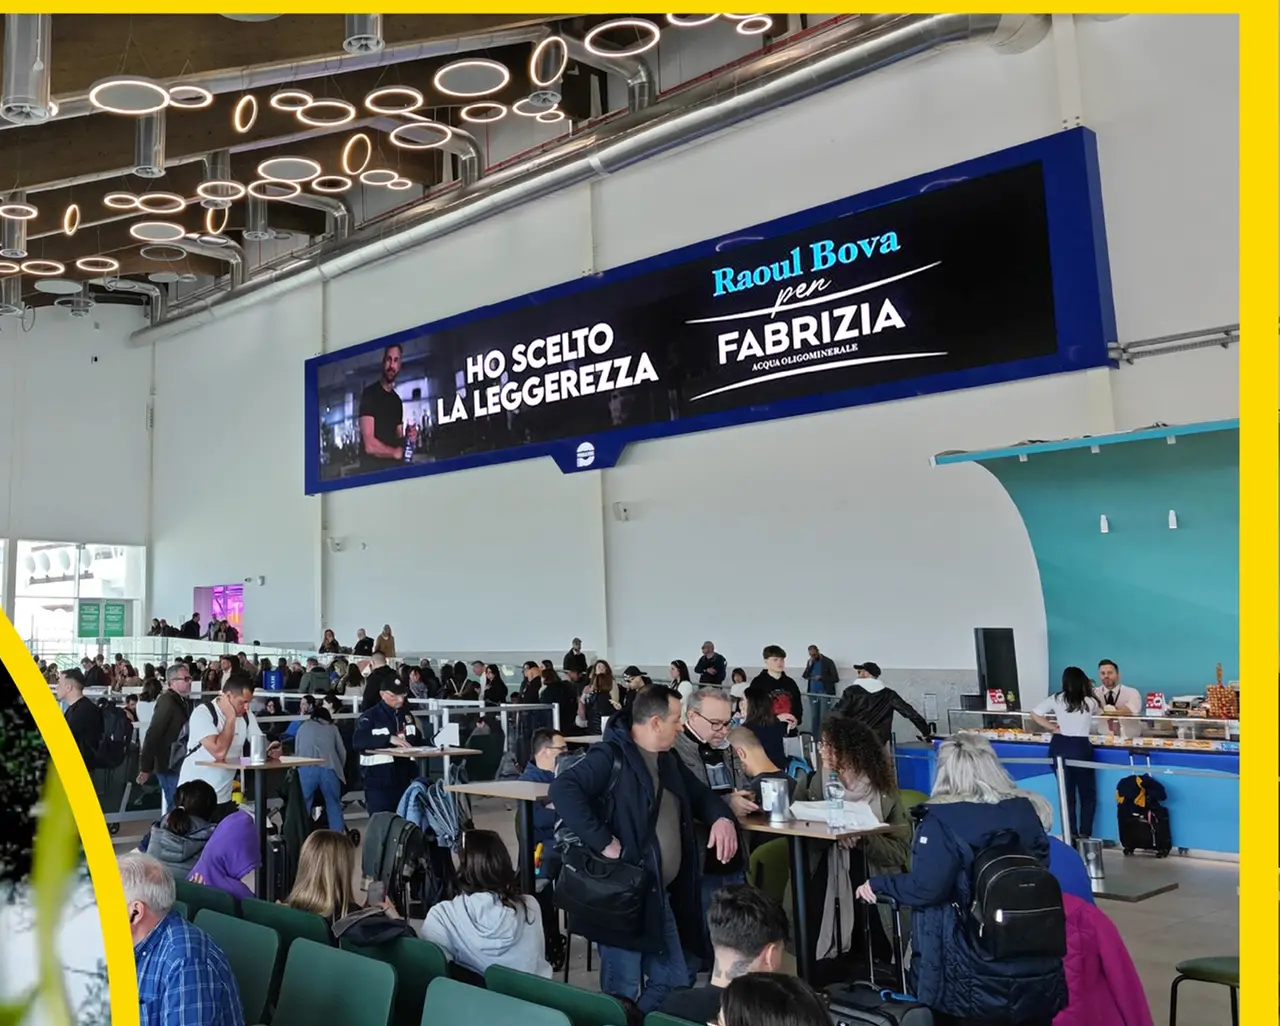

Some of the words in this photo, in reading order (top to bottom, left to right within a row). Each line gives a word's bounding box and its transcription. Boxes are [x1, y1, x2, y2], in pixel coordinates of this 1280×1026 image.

[712, 247, 803, 297] Raoul
[809, 229, 900, 274] Bova
[771, 277, 832, 317] per
[466, 350, 507, 383] HO
[511, 323, 614, 374] SCELTO
[717, 299, 906, 364] FABRIZIA
[751, 358, 780, 371] ACQUA
[780, 343, 858, 365] OLIGOMINERALE
[436, 390, 470, 424] LA
[473, 353, 659, 419] LEGGEREZZA
